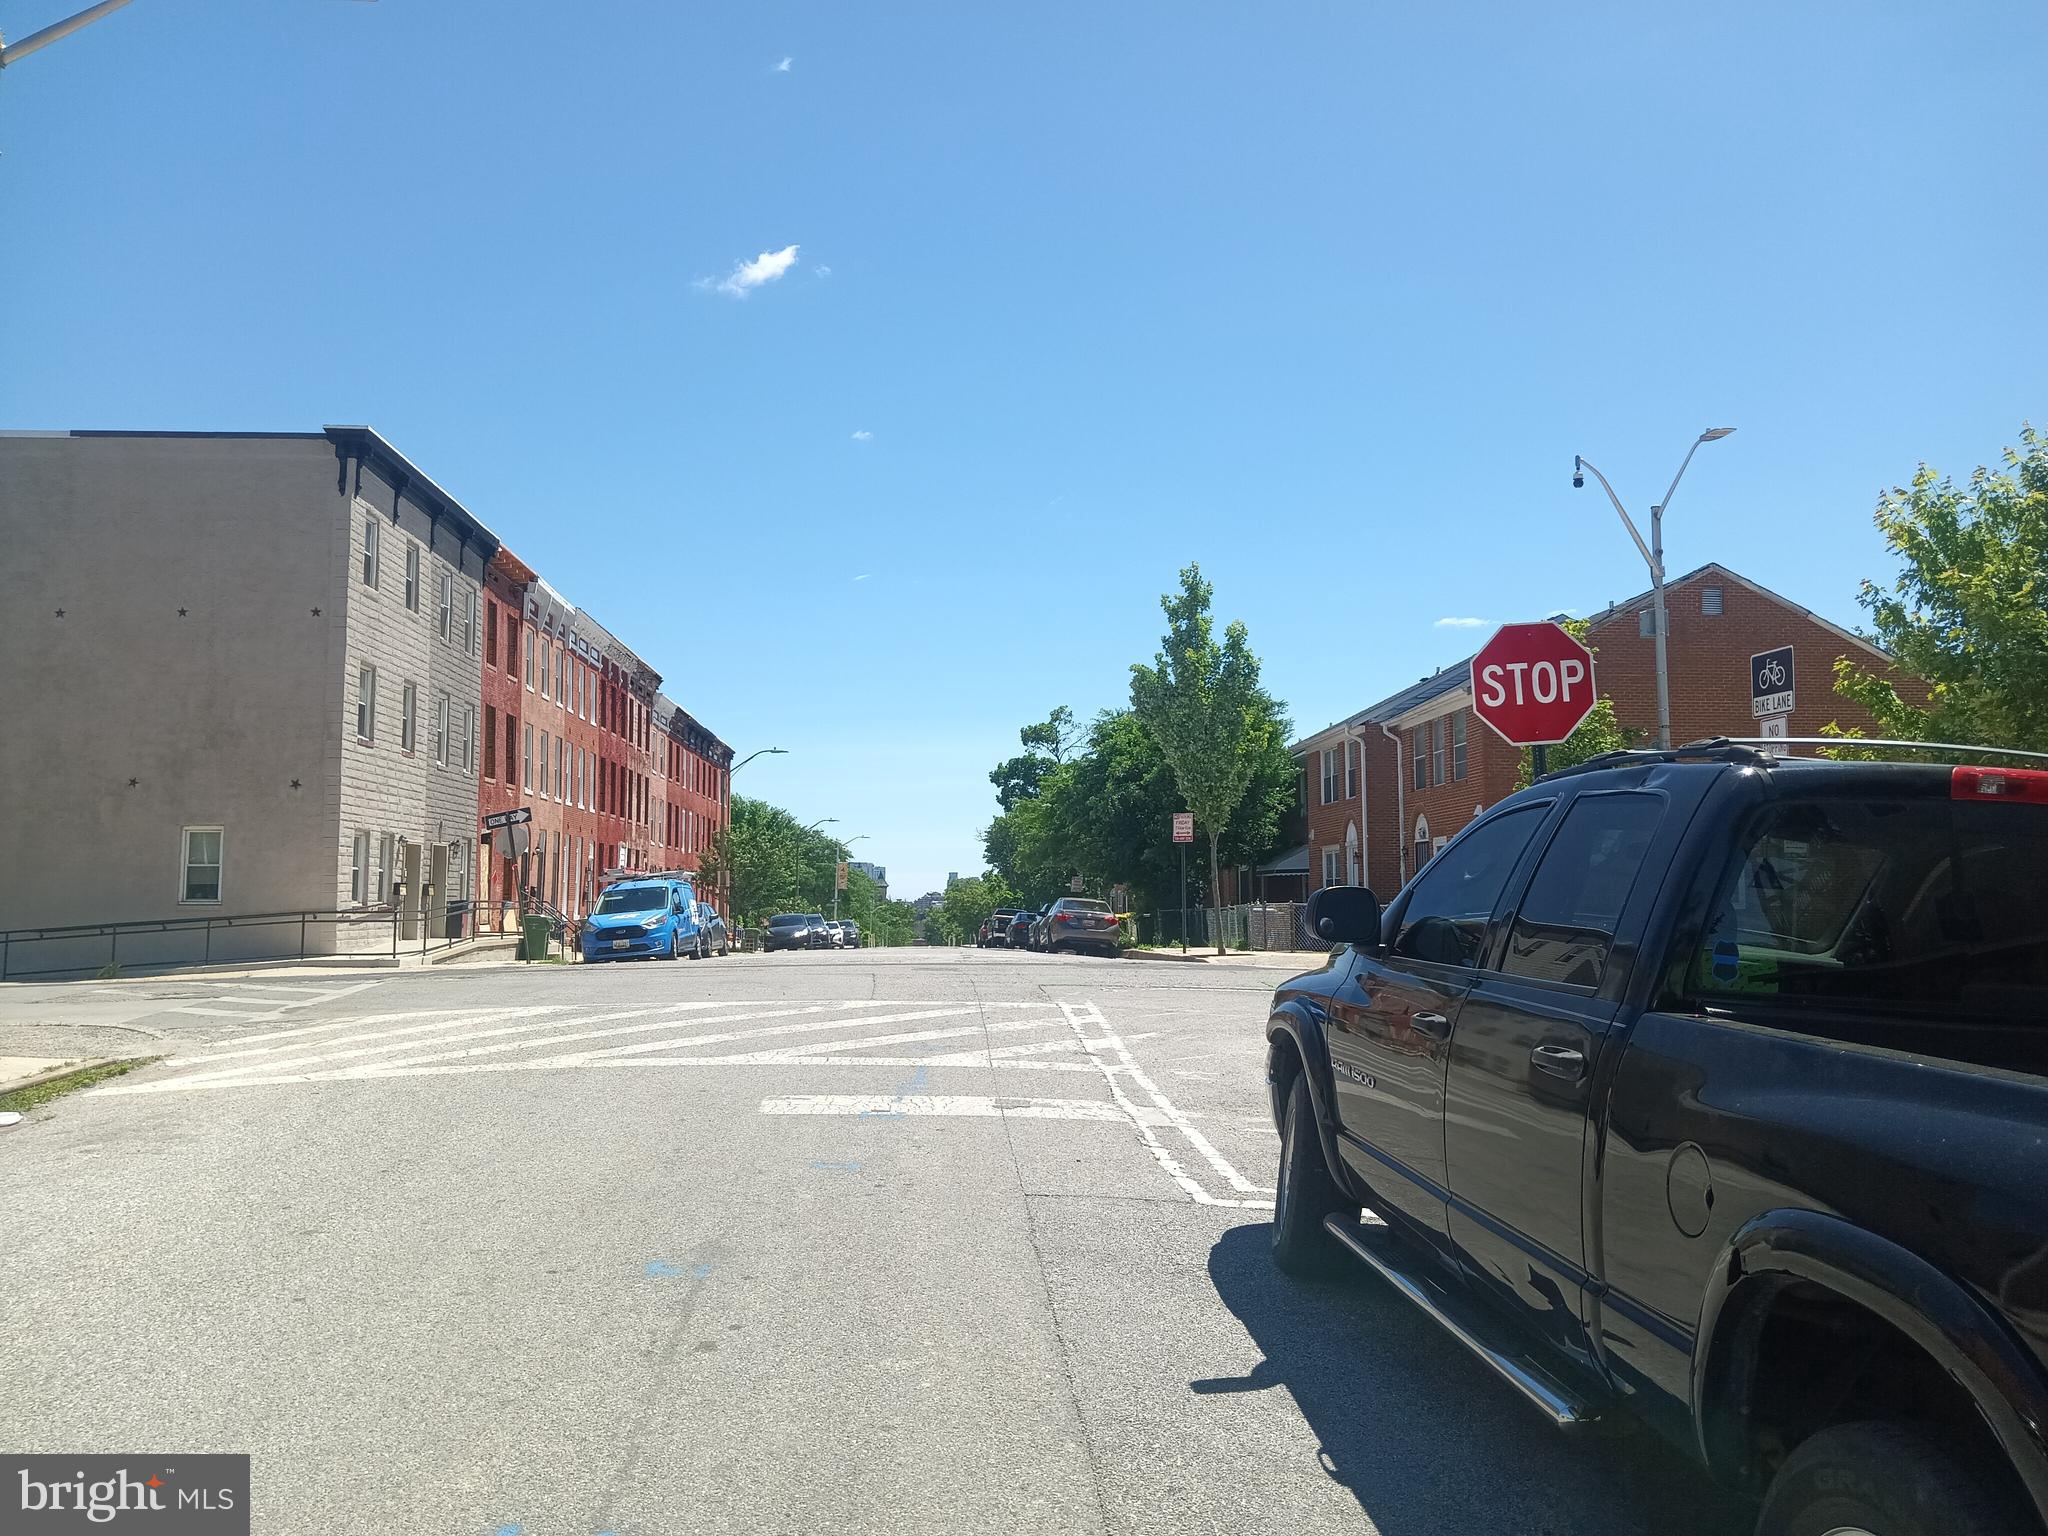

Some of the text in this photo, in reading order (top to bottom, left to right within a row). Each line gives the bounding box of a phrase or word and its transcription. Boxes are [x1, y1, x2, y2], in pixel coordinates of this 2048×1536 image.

[1481, 659, 1585, 707] STOP
[1755, 694, 1791, 713] BIKE LANE
[1768, 724, 1779, 738] NO
